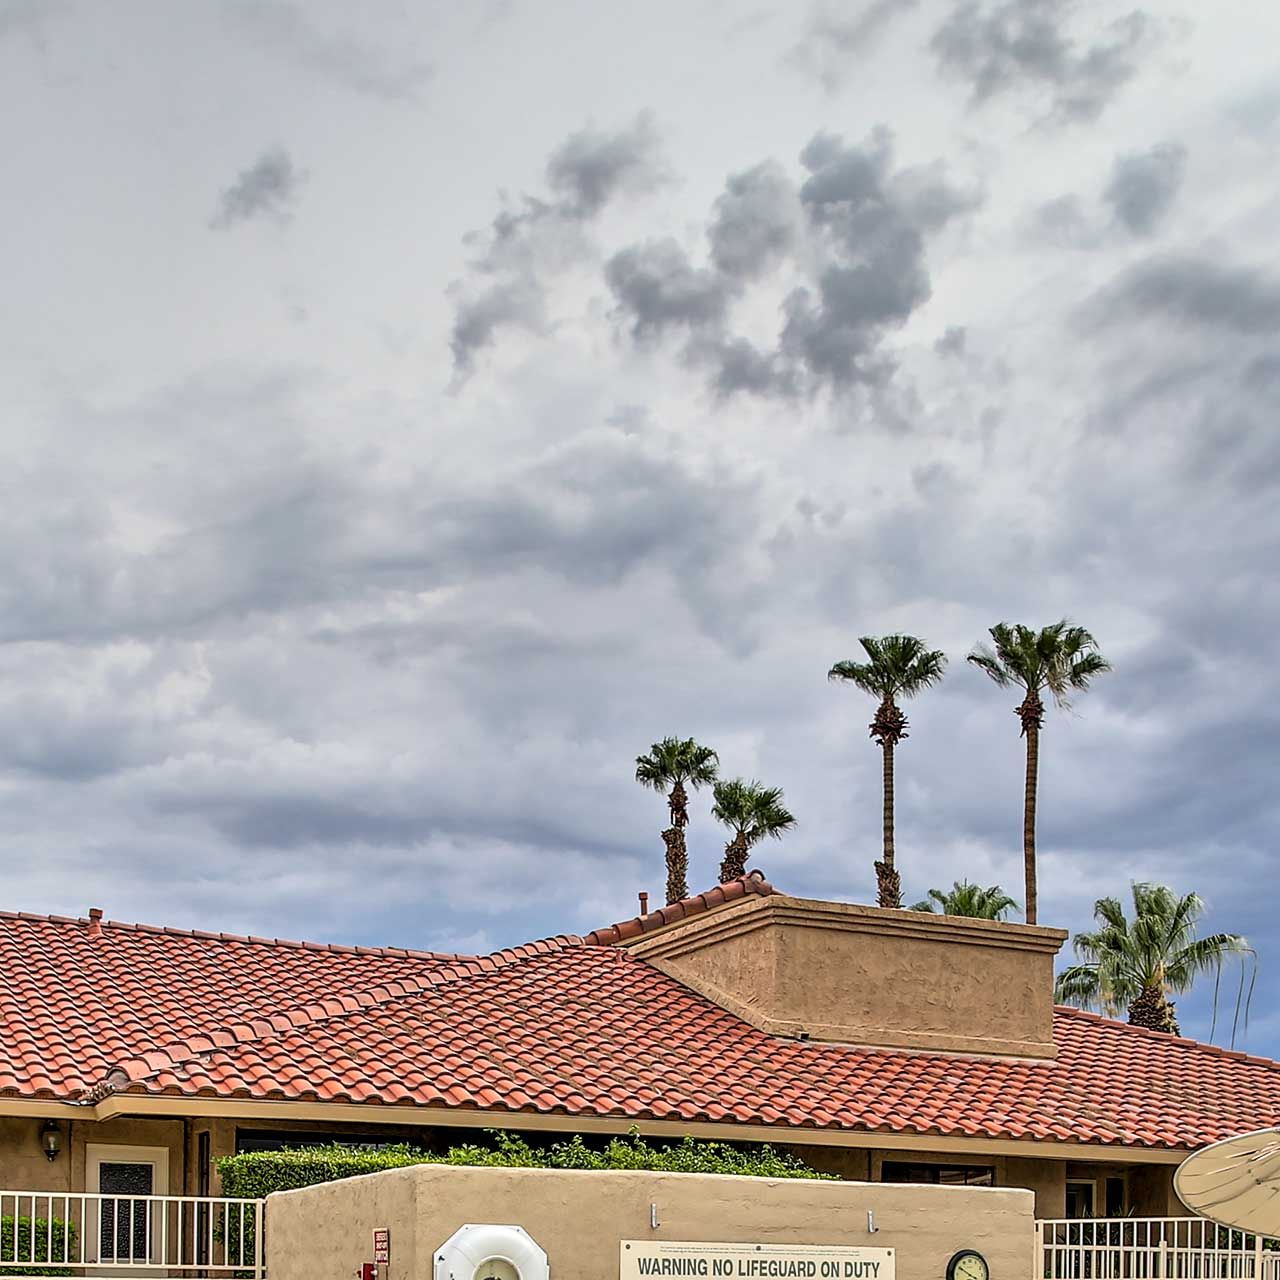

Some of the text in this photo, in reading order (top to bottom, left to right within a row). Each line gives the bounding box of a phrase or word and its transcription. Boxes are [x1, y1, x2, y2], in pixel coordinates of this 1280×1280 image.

[637, 1257, 881, 1279] WARNING NO LIFEGUARD ON DUTY
